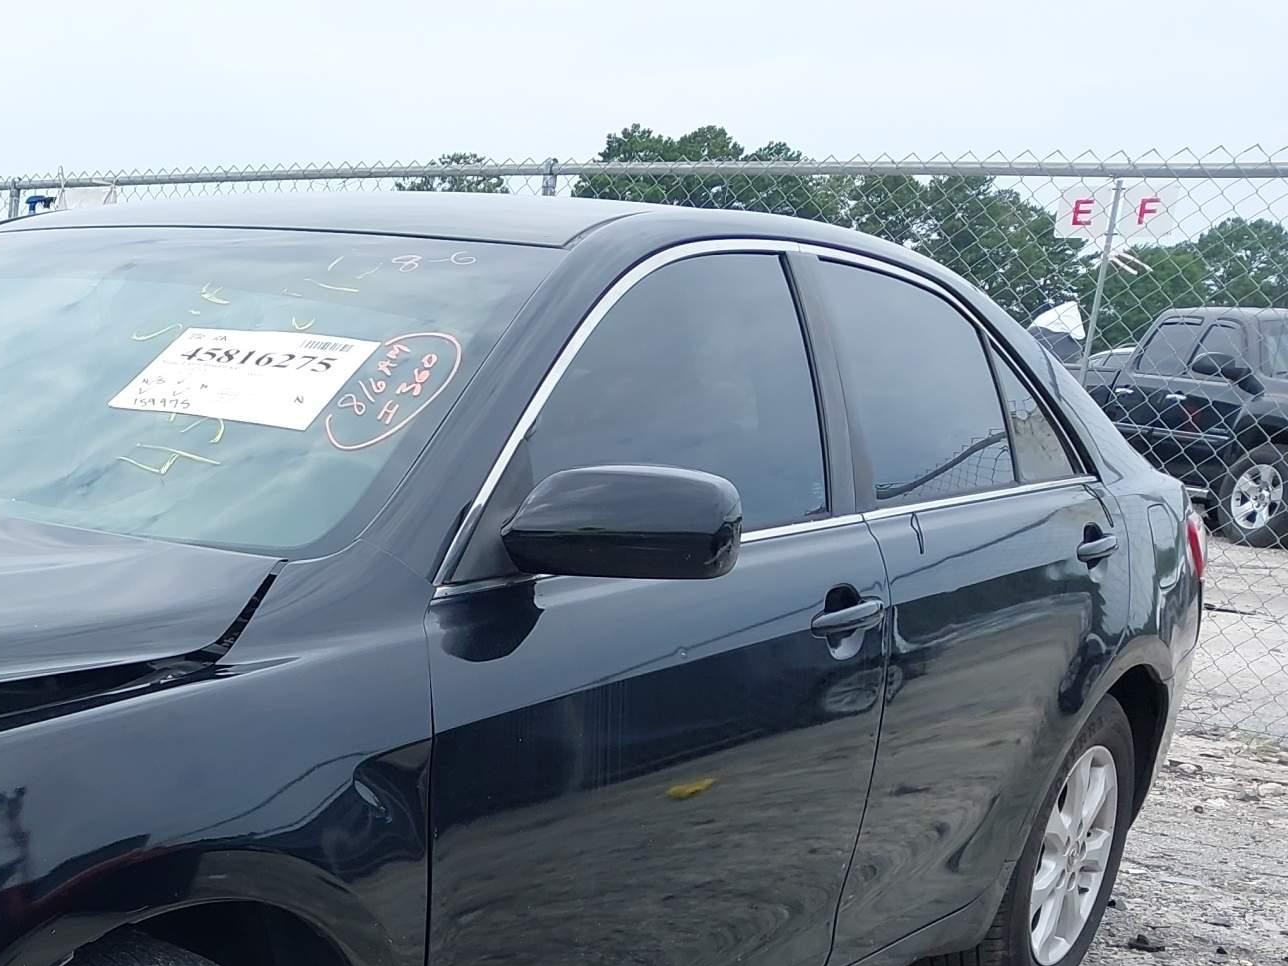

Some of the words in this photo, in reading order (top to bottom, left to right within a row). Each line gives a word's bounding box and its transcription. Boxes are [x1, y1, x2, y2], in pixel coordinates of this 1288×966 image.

[1072, 199, 1094, 225] E
[1137, 197, 1160, 225] F
[180, 346, 338, 374] 45816275
